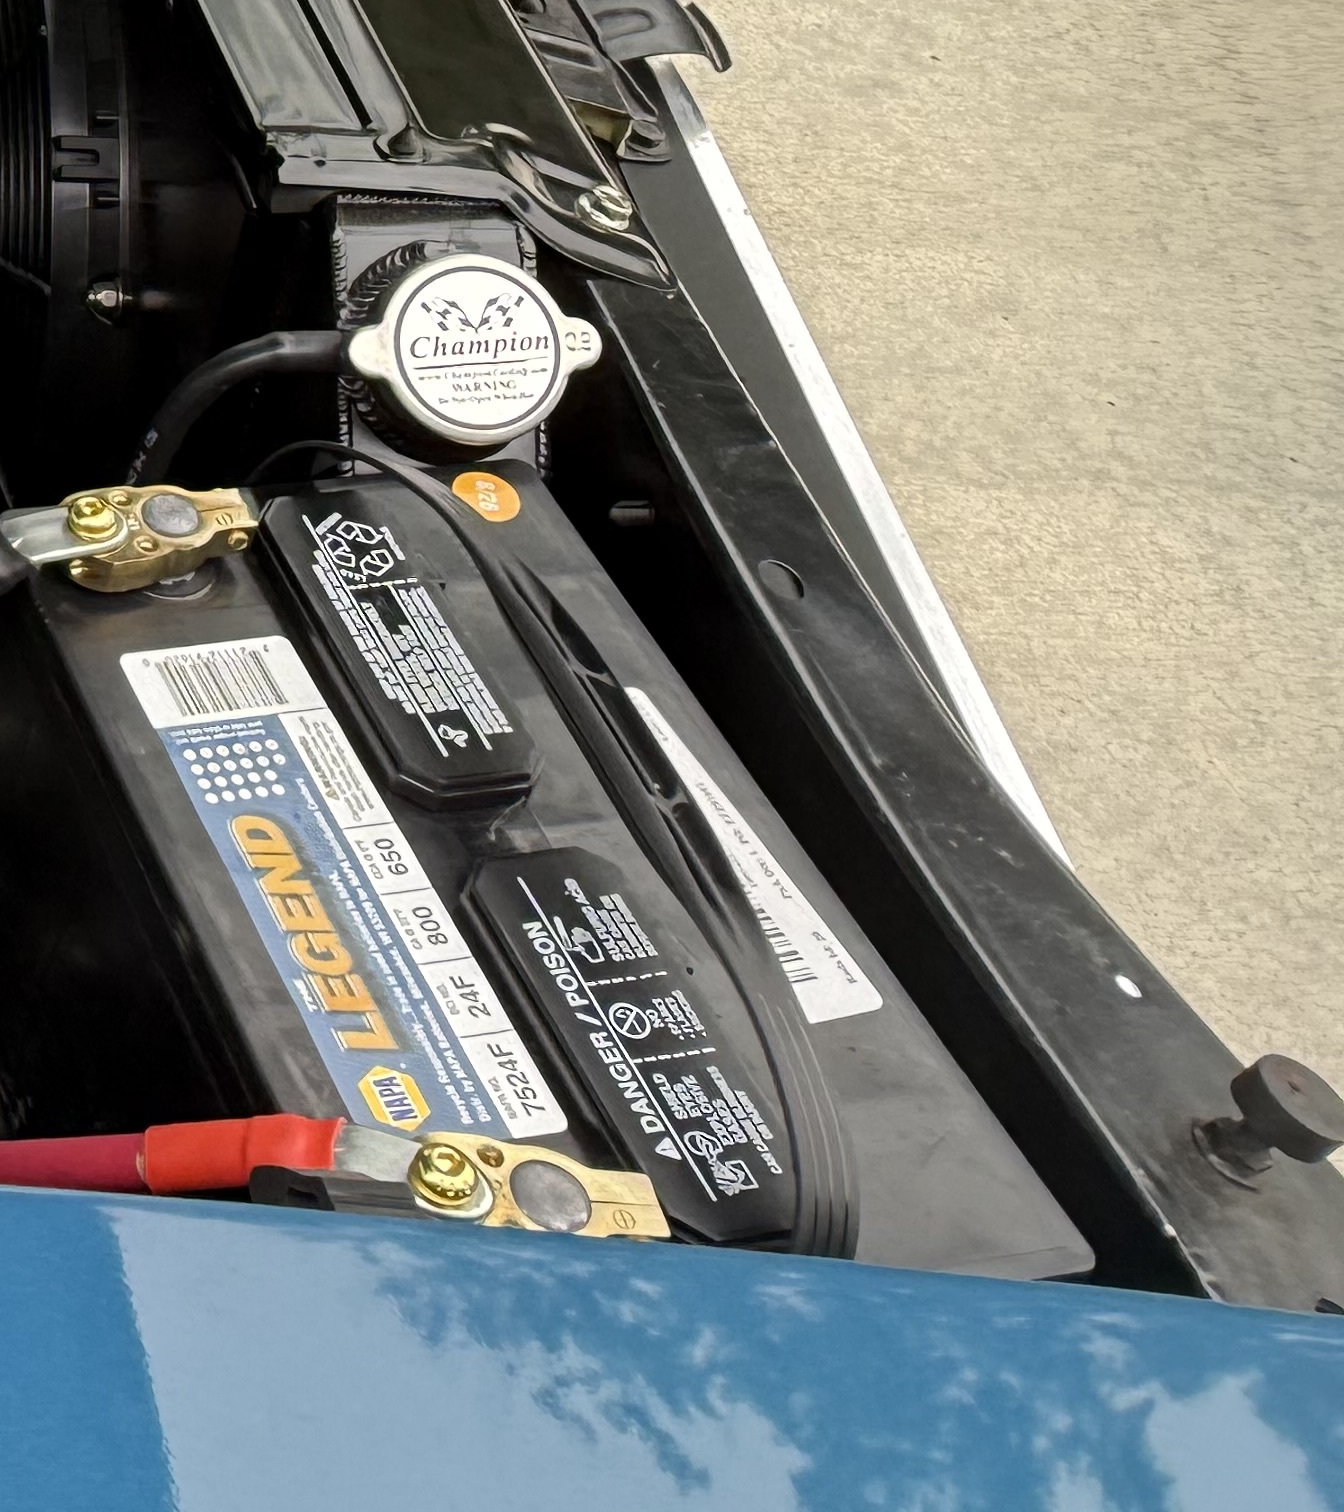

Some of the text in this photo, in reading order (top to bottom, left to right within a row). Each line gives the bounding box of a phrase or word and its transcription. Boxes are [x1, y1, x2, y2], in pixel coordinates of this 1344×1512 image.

[409, 331, 550, 359] Champion
[371, 837, 410, 875] 650
[227, 814, 399, 1051] LEGEND
[409, 906, 450, 945] 800
[522, 921, 590, 1008] POISON
[292, 978, 319, 1011] THE
[448, 975, 492, 1018] 24F
[368, 1076, 419, 1120] NAPA
[485, 1042, 548, 1116] 7524F
[588, 1031, 665, 1133] DANGER
